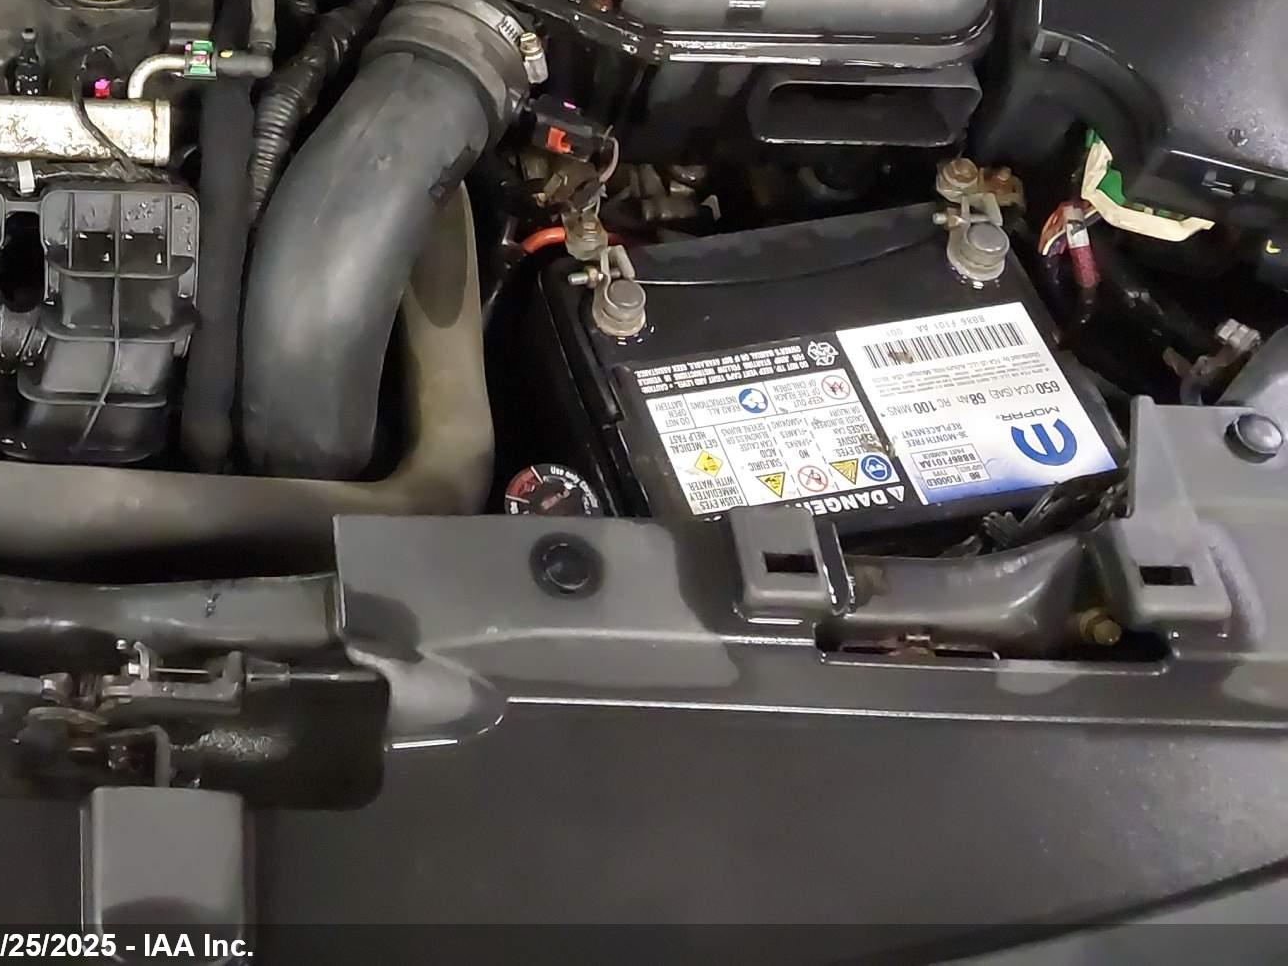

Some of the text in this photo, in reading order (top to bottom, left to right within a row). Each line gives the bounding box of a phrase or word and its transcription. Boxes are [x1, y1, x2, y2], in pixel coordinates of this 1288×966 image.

[772, 379, 816, 392] OF CHILDREN
[1013, 384, 1034, 395] CCA
[1035, 380, 1060, 394] 650
[774, 387, 820, 402] OF THE REACH
[988, 386, 1013, 399] (SAE)
[654, 400, 682, 412] BATTERY
[690, 396, 737, 410] INSTRUCTIONS
[808, 396, 824, 405] KEEP
[936, 398, 951, 408] RC
[668, 408, 686, 418] OPEN
[706, 404, 740, 416] READ ALL
[912, 400, 936, 414] 100
[664, 416, 690, 428] DO NOT
[720, 426, 742, 436] BURNS
[901, 422, 962, 439] REPLACEMENT
[668, 432, 706, 444] HELP FAST
[904, 438, 926, 448] FREE
[670, 438, 718, 454] GET MEDICAL
[760, 448, 776, 458] ACID
[798, 448, 810, 458] NO
[550, 466, 565, 476] Use
[746, 458, 782, 472] SULFURIC
[714, 476, 735, 486] WITH
[926, 474, 961, 486] FLOODED
[688, 486, 739, 502] IMMEDIATELY
[700, 496, 744, 510] FLUSH EYES
